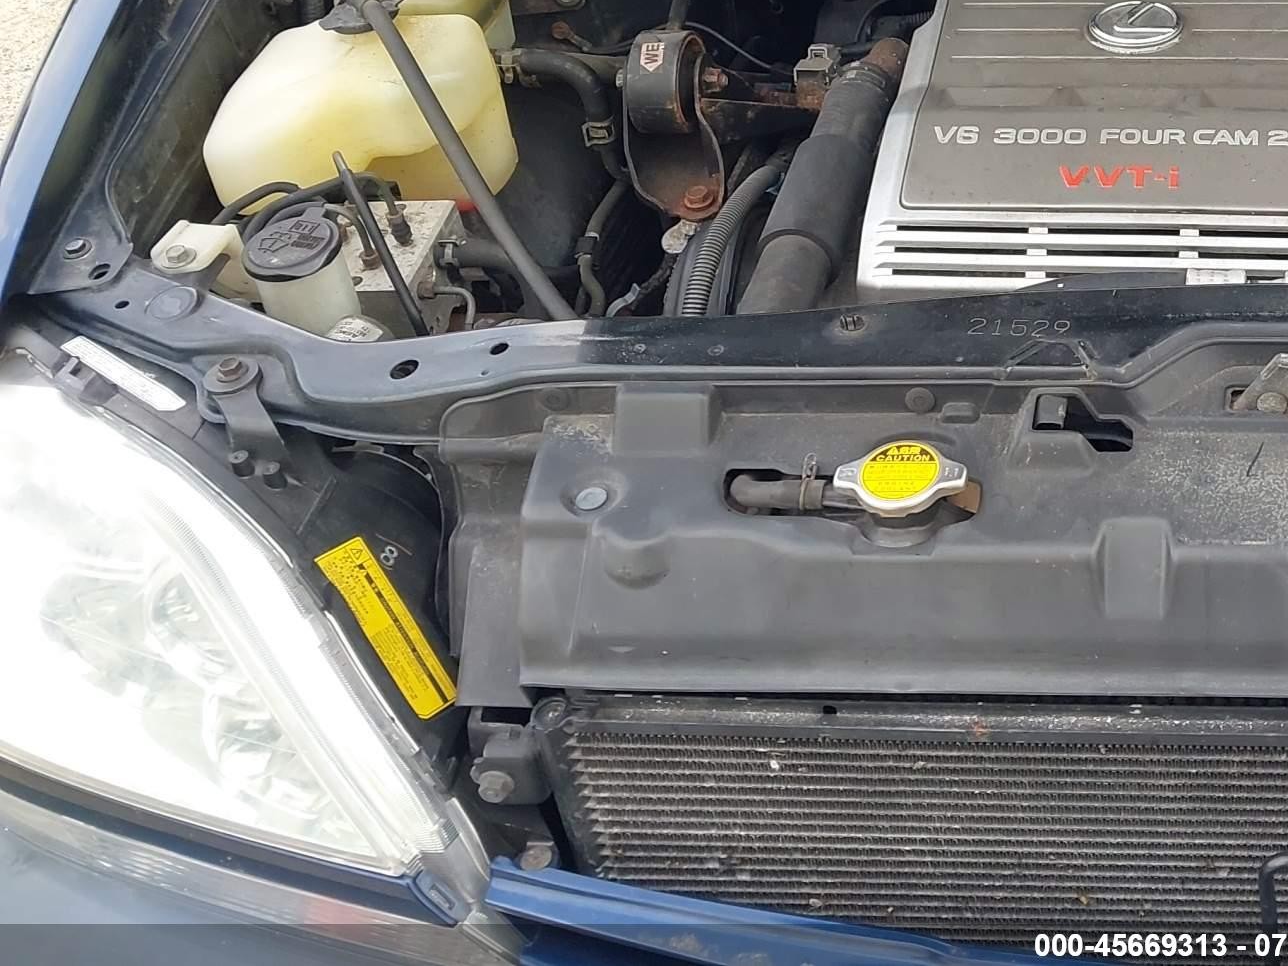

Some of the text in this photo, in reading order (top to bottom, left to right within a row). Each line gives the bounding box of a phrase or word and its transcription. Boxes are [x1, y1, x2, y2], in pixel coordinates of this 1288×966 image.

[933, 125, 980, 145] V6
[993, 127, 1087, 145] 3000
[1099, 128, 1187, 146] FOUR
[1192, 129, 1259, 146] CAM
[1059, 165, 1180, 189] VVT-i
[967, 317, 1071, 337] 21529
[876, 454, 931, 462] CAUTION
